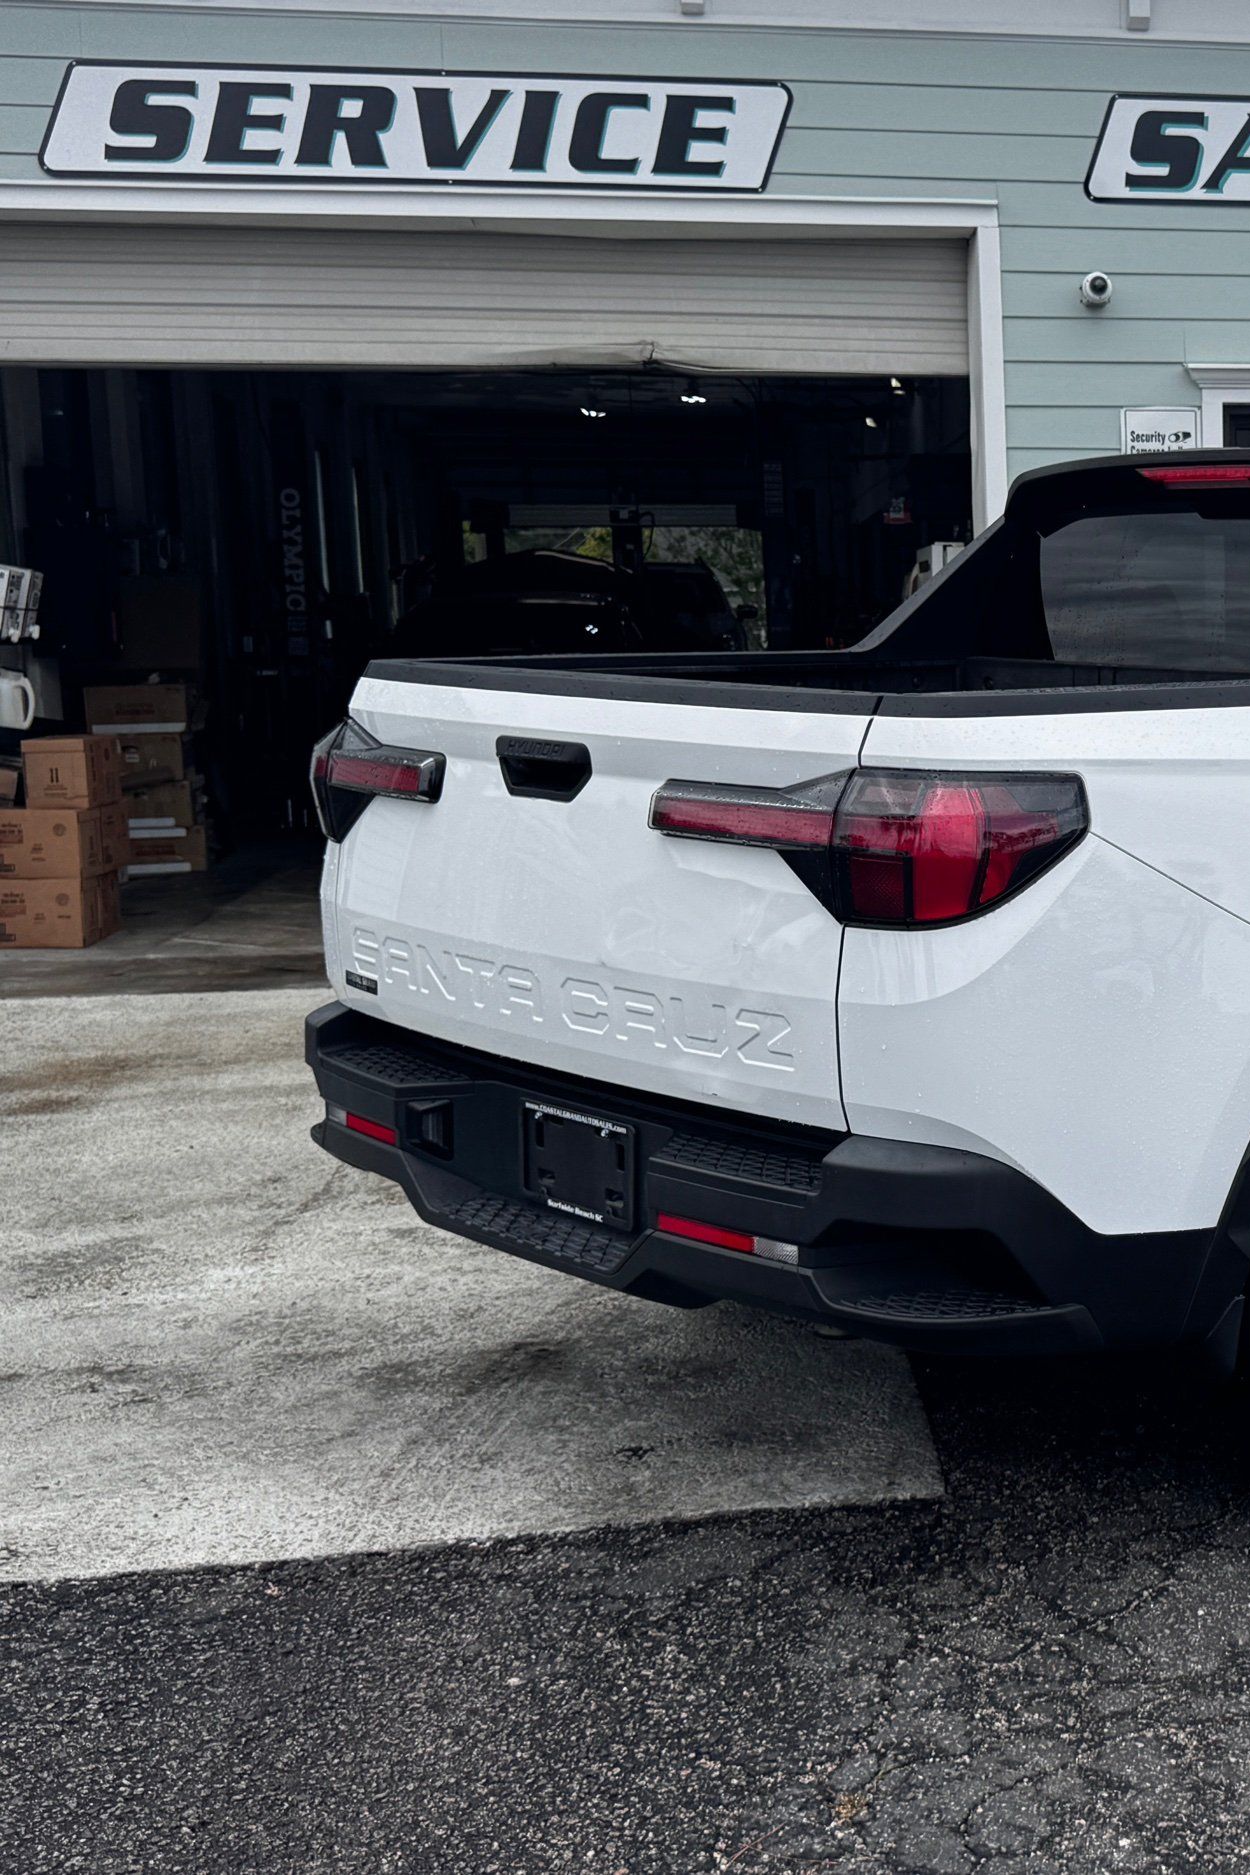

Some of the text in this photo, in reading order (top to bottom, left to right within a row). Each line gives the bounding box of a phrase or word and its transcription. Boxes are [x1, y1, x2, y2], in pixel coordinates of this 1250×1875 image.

[103, 78, 737, 177] SERVICE
[1130, 430, 1166, 446] Security
[279, 487, 307, 612] OLYMPIC
[507, 739, 566, 756] HYUNDAI
[352, 926, 796, 1072] SANTA CRUZ
[574, 1206, 595, 1220] Beach
[595, 1213, 604, 1223] SC
